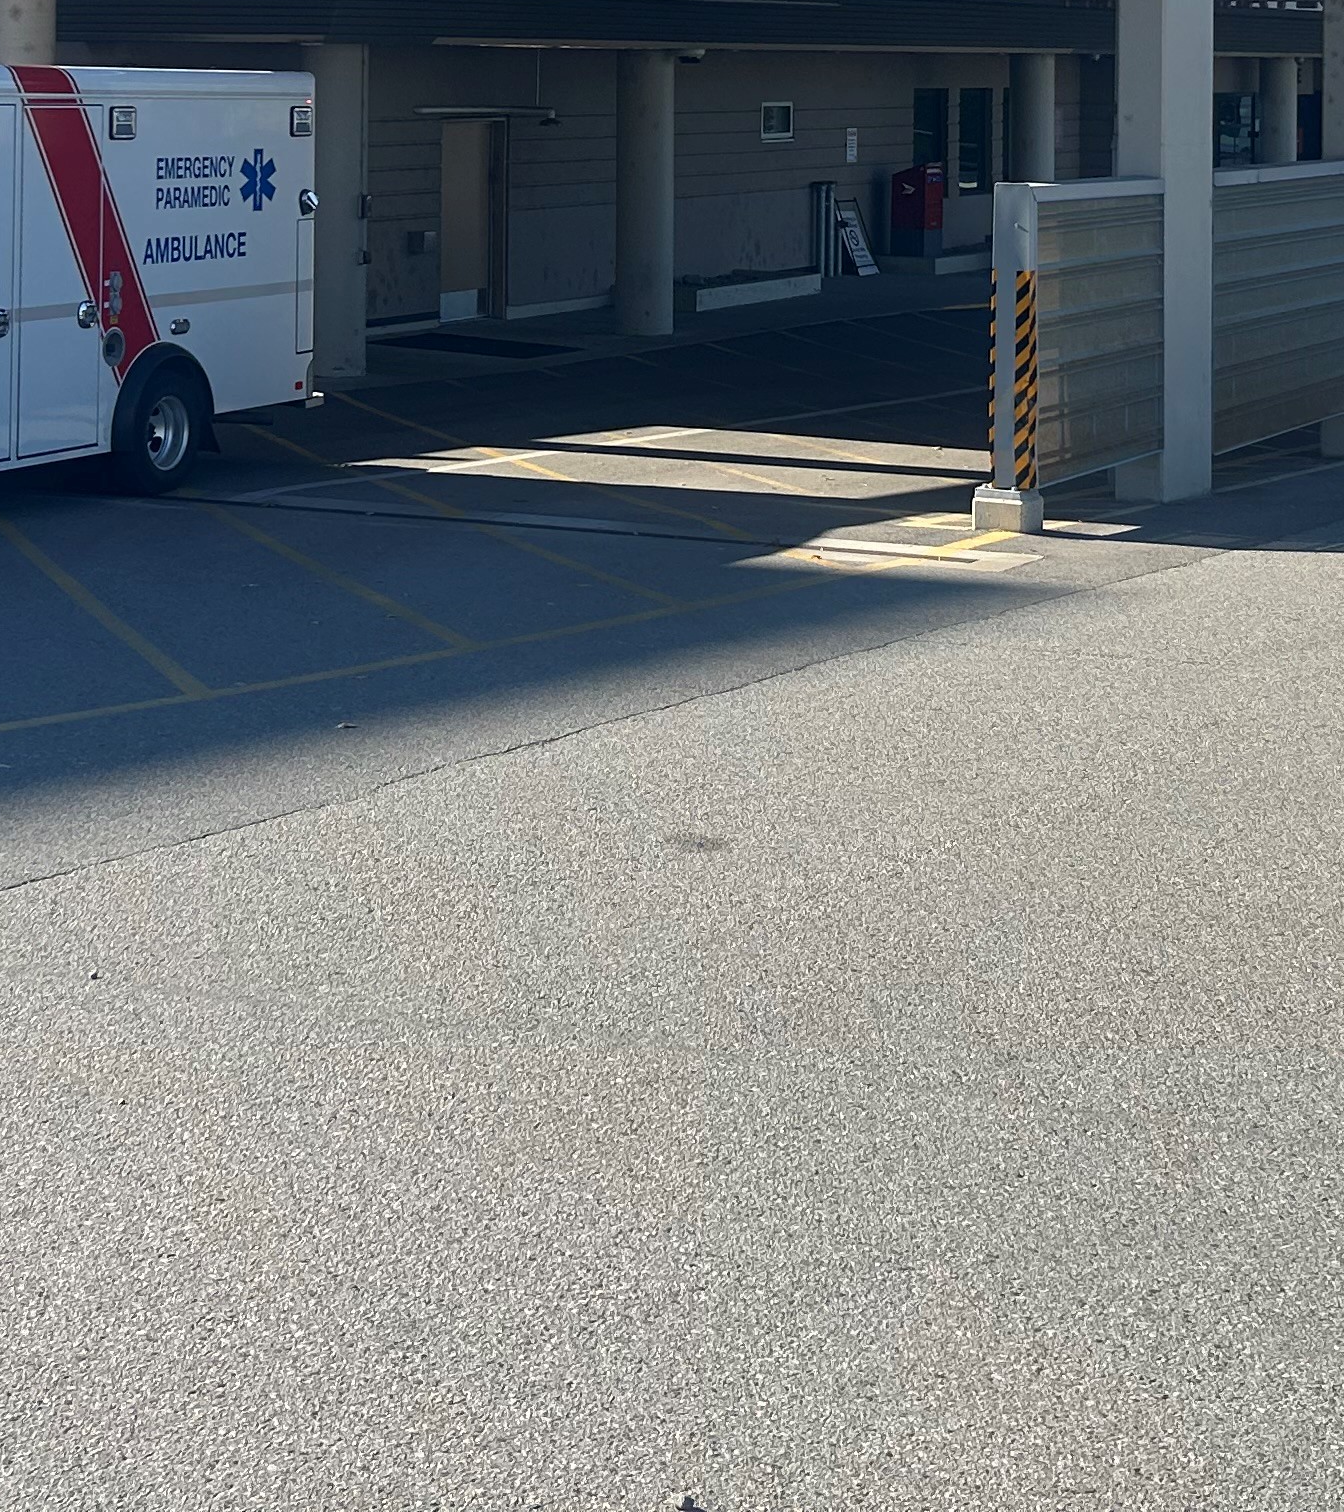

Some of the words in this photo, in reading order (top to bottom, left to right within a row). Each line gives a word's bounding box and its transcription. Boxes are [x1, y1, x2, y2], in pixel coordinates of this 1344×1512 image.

[156, 155, 235, 180] EMERGENCY
[156, 184, 231, 209] PARAMEDIC
[142, 231, 247, 265] AMBULANCE
